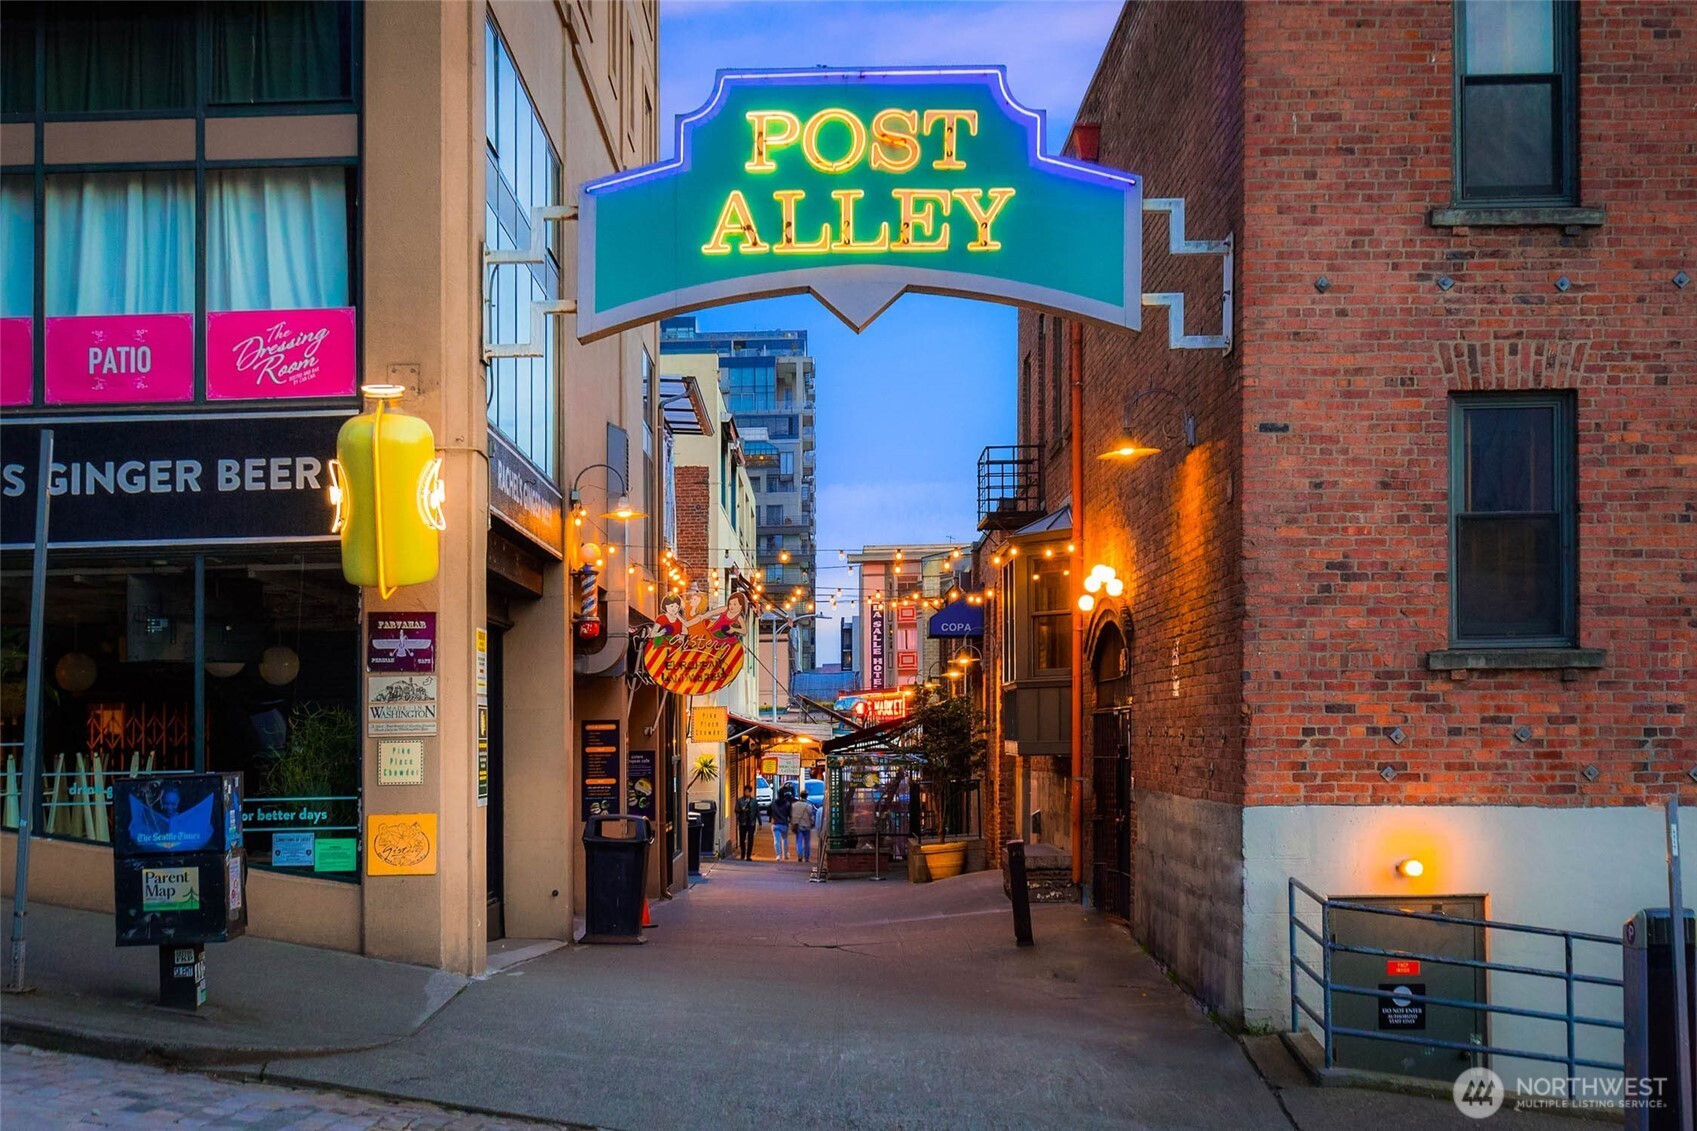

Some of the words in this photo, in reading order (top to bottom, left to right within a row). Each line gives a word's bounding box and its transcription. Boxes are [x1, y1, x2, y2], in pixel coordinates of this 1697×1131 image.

[745, 107, 978, 173] POST
[701, 187, 1016, 255] ALLEY
[266, 320, 292, 343] The
[232, 328, 330, 371] Dressing
[89, 345, 151, 375] PATIO
[252, 353, 320, 385] Room
[49, 459, 203, 497] GINGER
[217, 456, 323, 492] BEER
[941, 623, 972, 632] COPA
[873, 621, 882, 655] SALLE
[873, 658, 882, 688] HOTE
[370, 704, 436, 719] WASHINGTON
[874, 699, 902, 716] MARKET
[389, 757, 413, 765] Place
[383, 768, 419, 777] Chowder
[257, 807, 296, 821] better
[298, 807, 328, 825] days
[137, 833, 152, 842] The
[152, 832, 177, 842] Seattle
[178, 831, 200, 841] Times
[145, 871, 189, 884] Parent
[145, 884, 176, 900] Map
